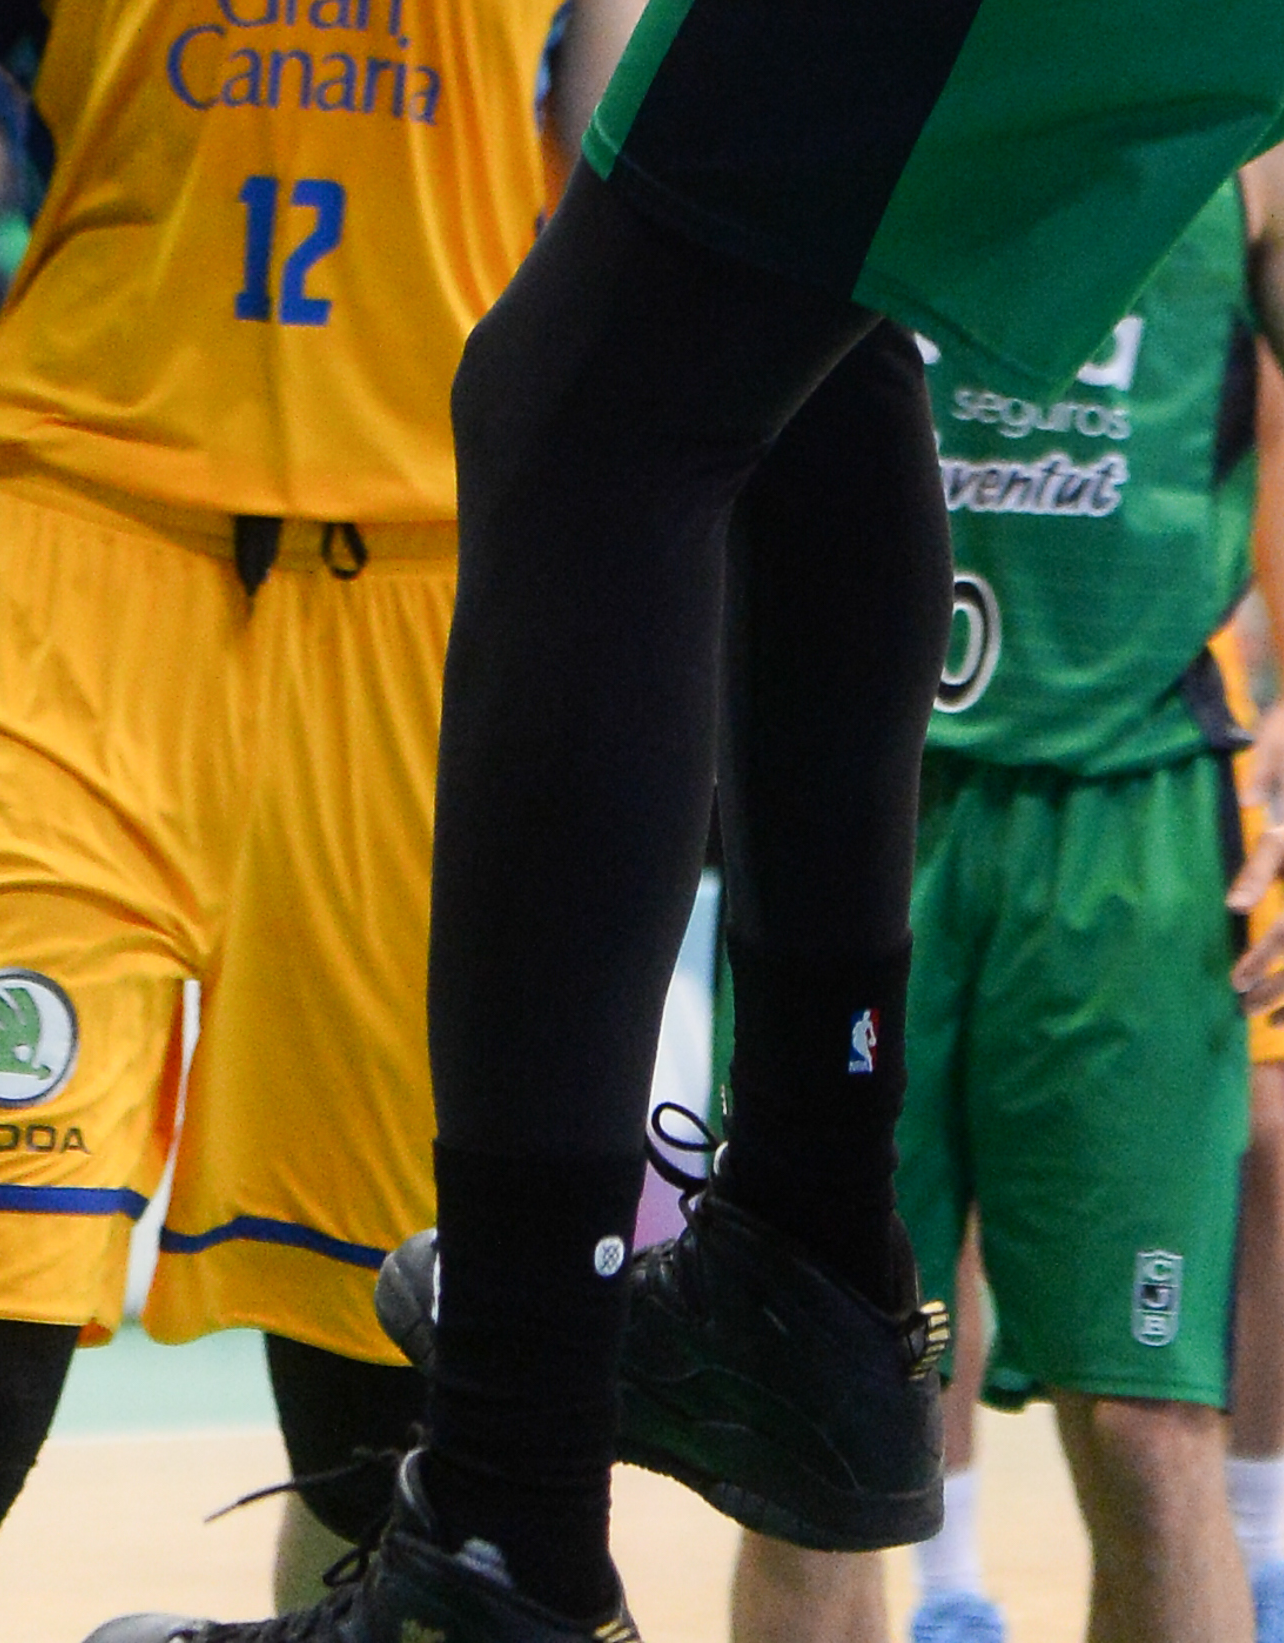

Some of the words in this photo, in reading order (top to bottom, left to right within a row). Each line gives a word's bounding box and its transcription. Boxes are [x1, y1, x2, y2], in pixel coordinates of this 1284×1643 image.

[167, 23, 441, 126] Canaria
[234, 175, 345, 326] 12
[952, 387, 1131, 439] seguros
[937, 451, 1131, 518] ventut
